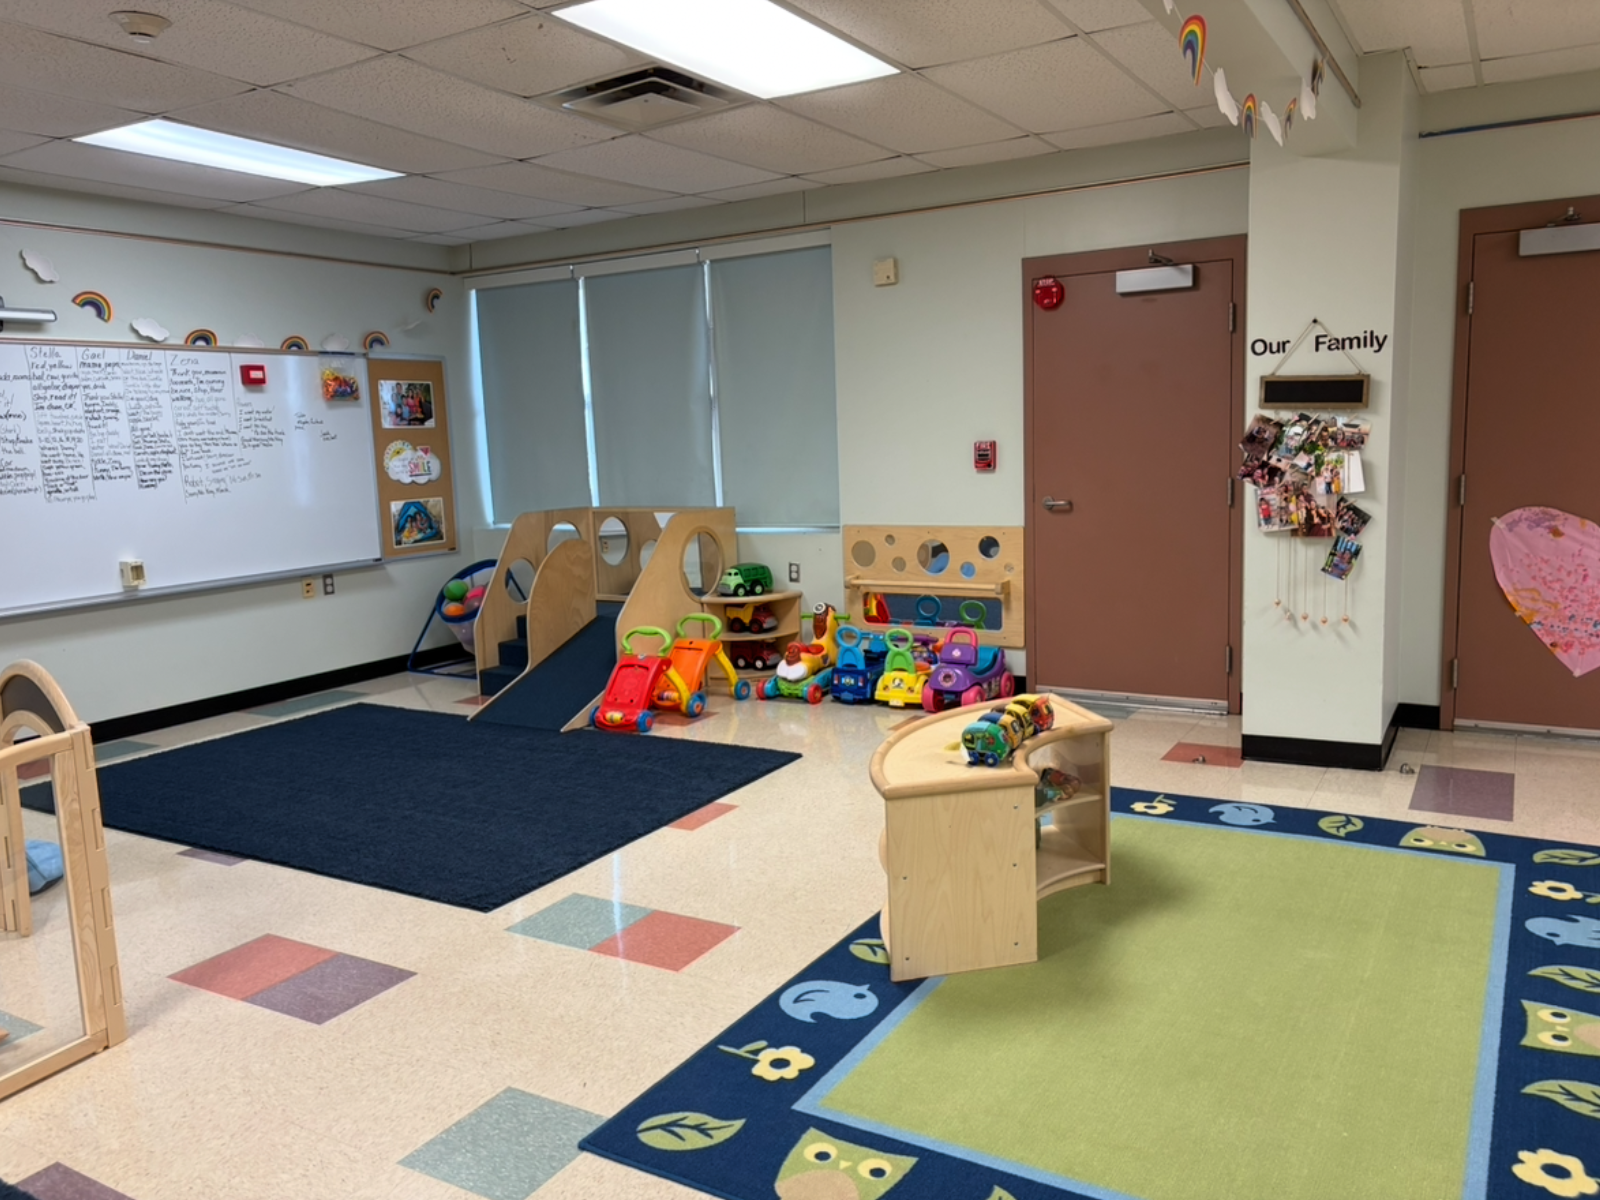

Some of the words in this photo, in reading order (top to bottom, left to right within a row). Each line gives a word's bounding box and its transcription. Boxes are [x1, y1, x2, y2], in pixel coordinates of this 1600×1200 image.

[1250, 338, 1291, 356] Our
[1314, 330, 1388, 353] Family
[30, 346, 62, 359] Stella
[81, 348, 105, 361] Gael
[126, 349, 153, 361] Daniel
